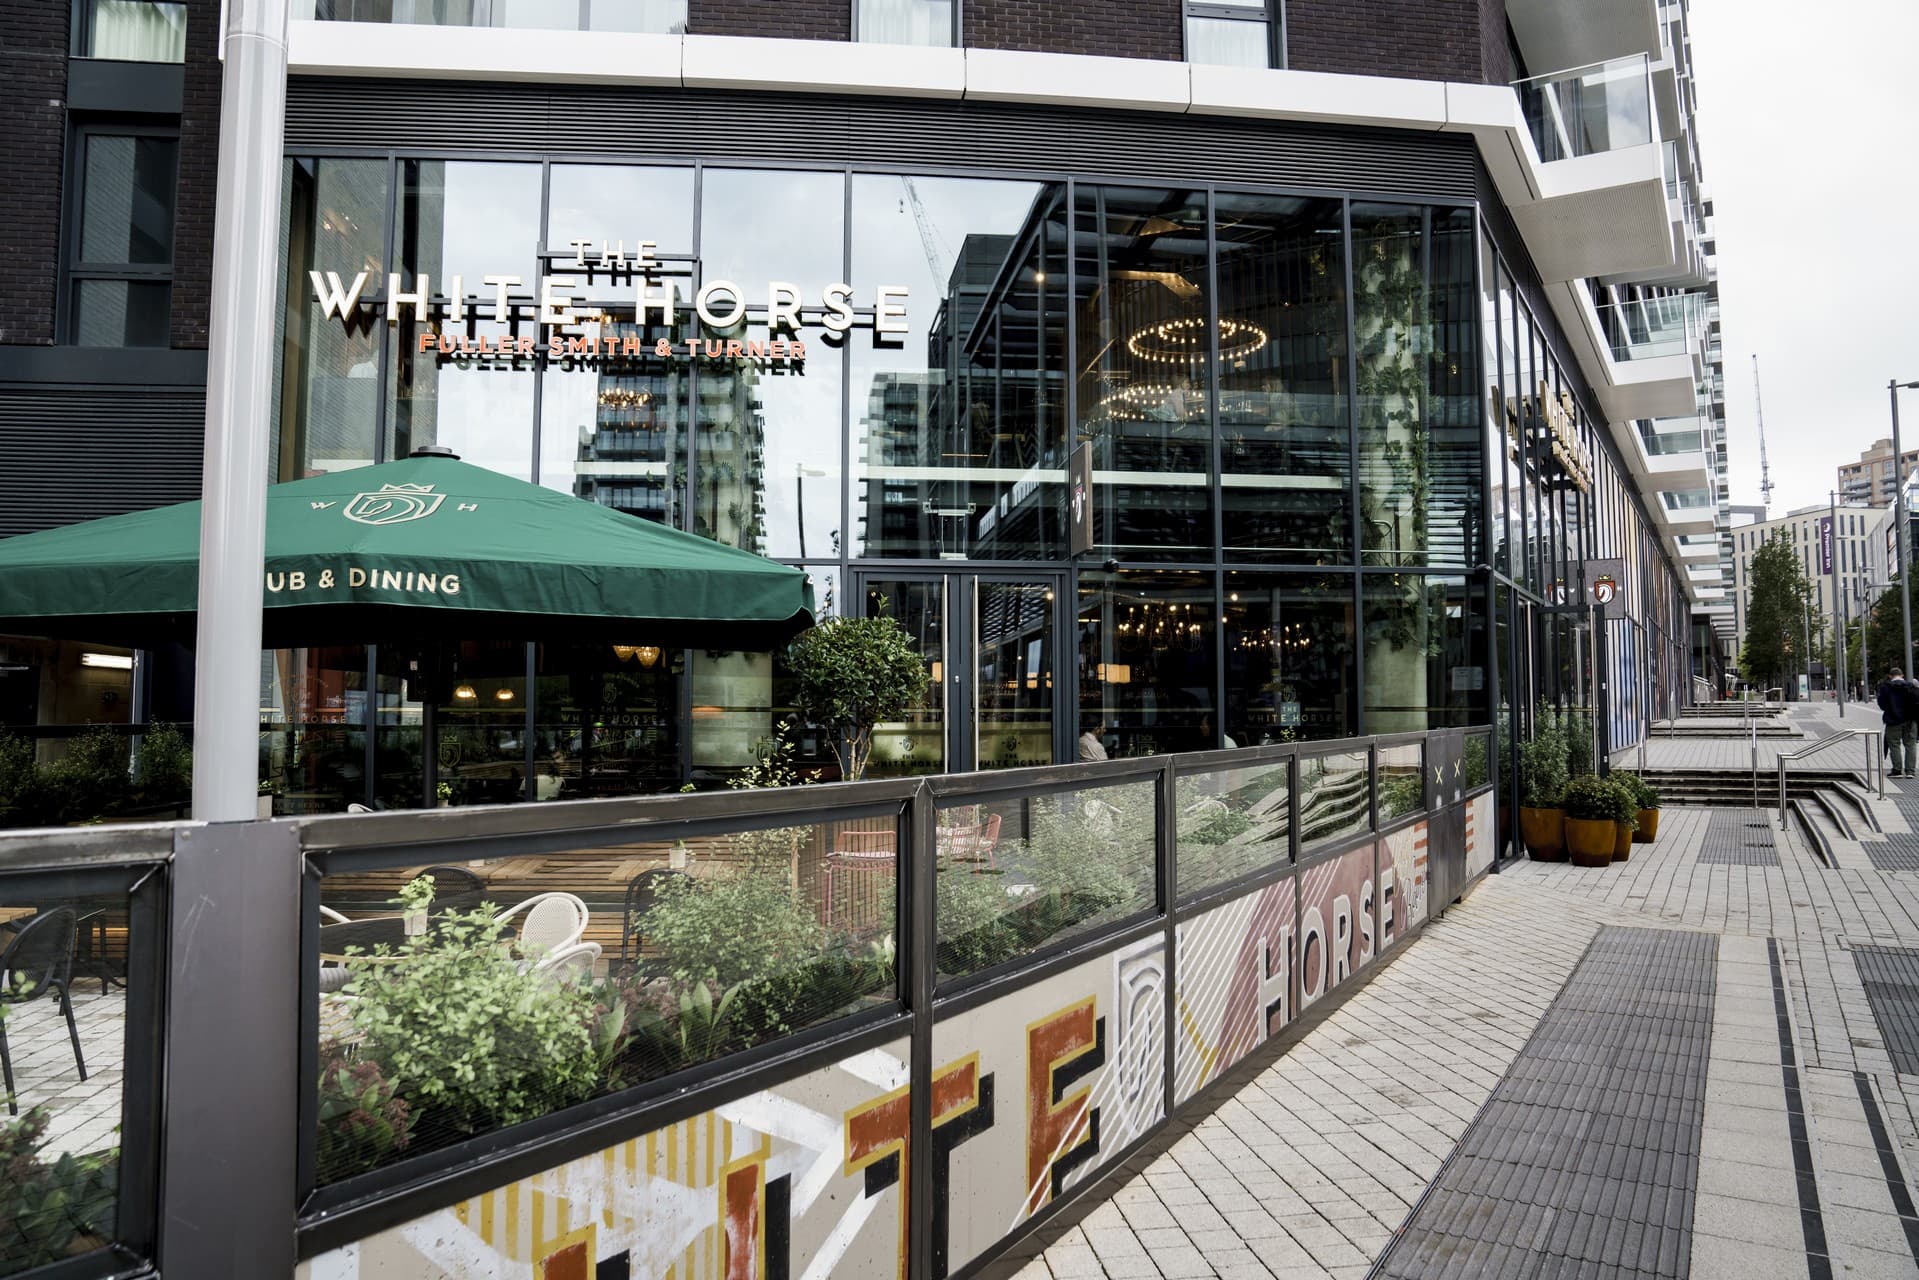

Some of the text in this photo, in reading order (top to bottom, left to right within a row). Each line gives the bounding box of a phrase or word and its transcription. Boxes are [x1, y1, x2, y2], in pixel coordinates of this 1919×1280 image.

[570, 240, 657, 268] THE
[309, 270, 909, 334] WHITE HORSE
[419, 334, 806, 360] FULLER SMITH & TURNER
[311, 501, 478, 512] W H
[267, 567, 461, 595] UB & DINING
[260, 714, 293, 723] HITE
[1256, 867, 1397, 1046] HORSE
